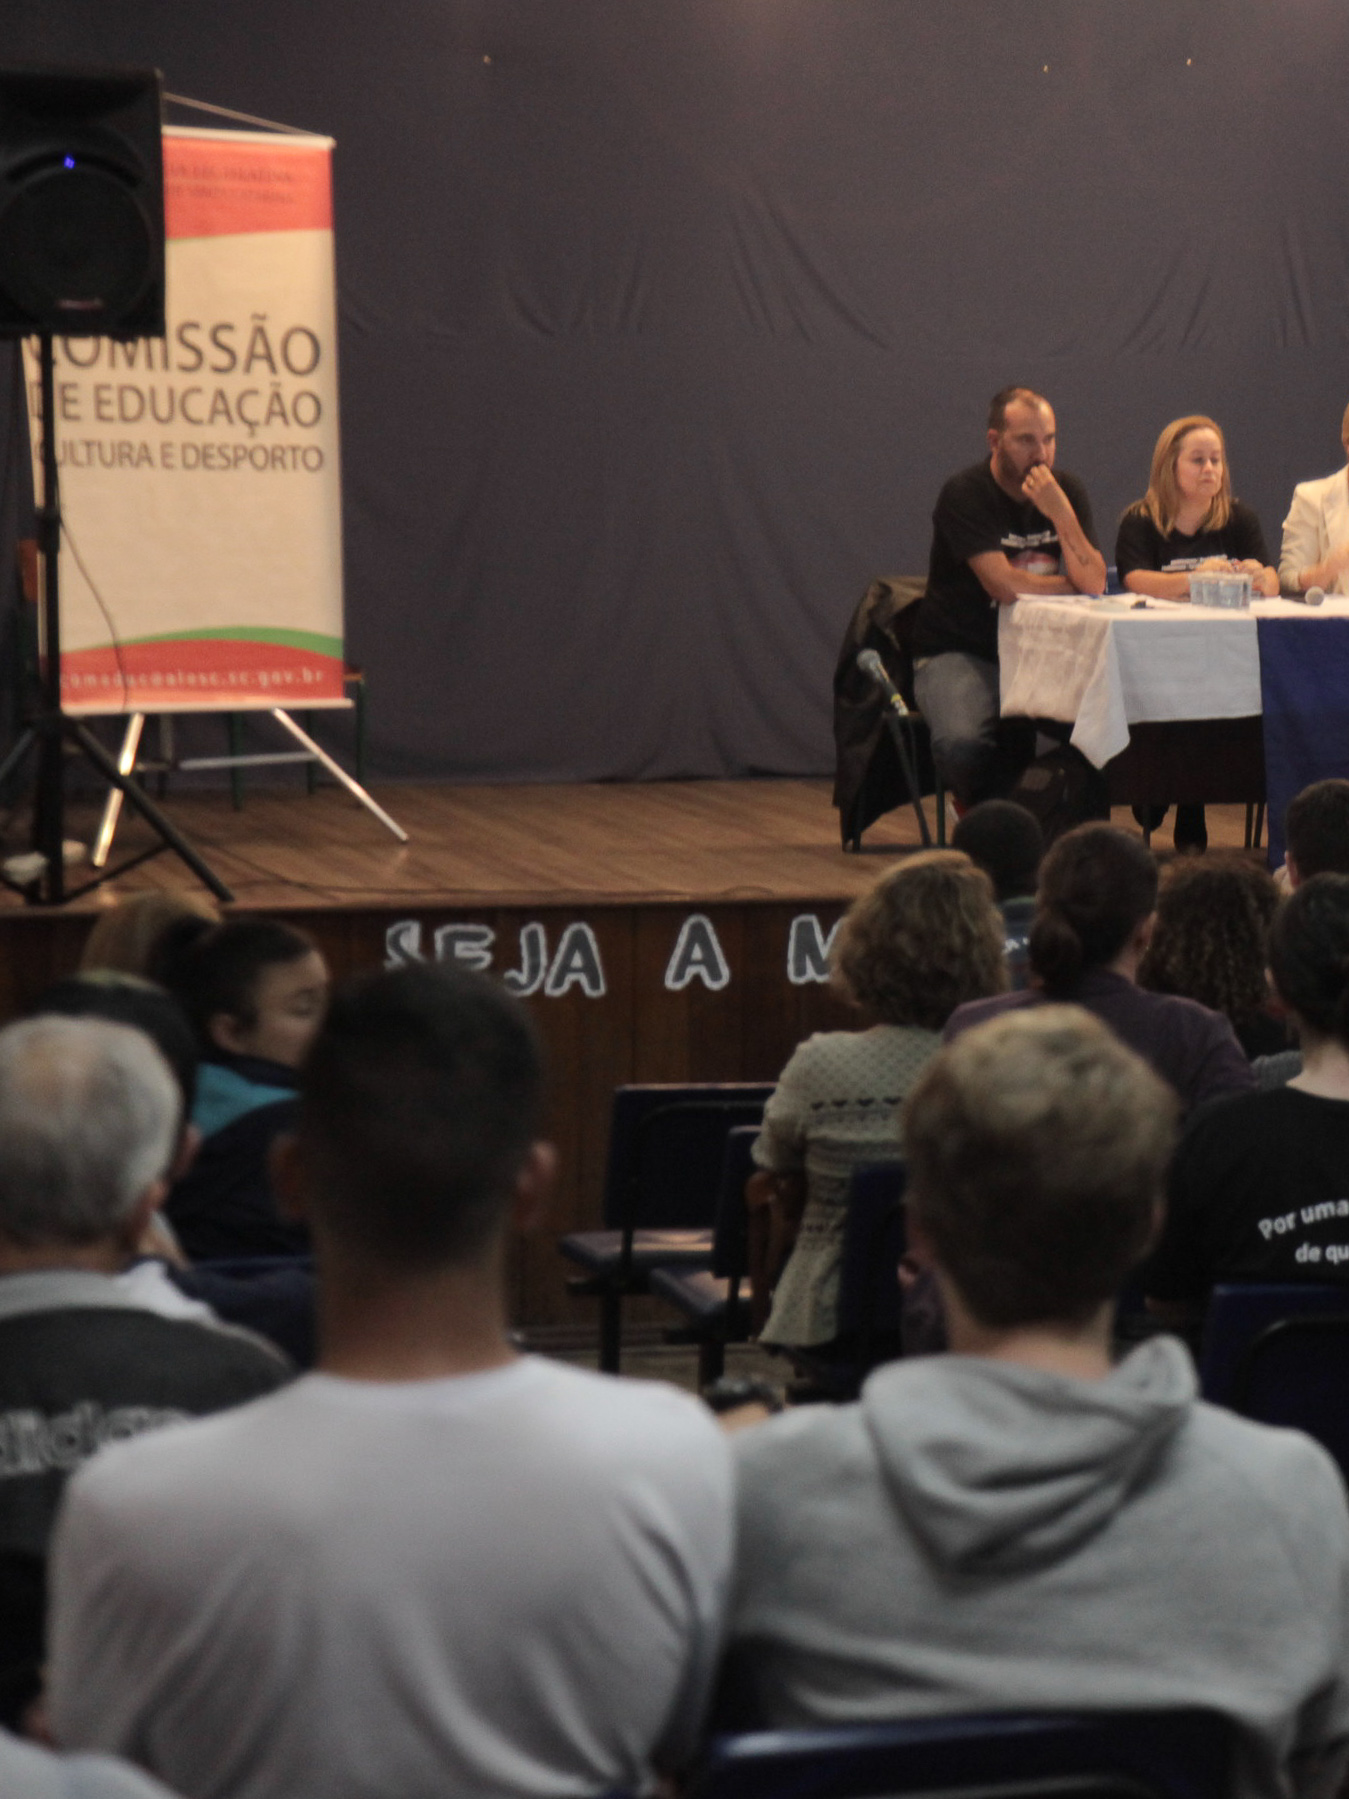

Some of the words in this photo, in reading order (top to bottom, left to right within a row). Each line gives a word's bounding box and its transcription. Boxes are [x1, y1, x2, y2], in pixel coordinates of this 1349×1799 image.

[94, 381, 322, 437] EDUCAÇÃO
[160, 441, 175, 468] E
[181, 442, 324, 473] DESPORTO
[664, 914, 730, 991] A
[1258, 1211, 1297, 1240] Por
[1301, 1199, 1349, 1224] uma
[1295, 1243, 1321, 1263] de
